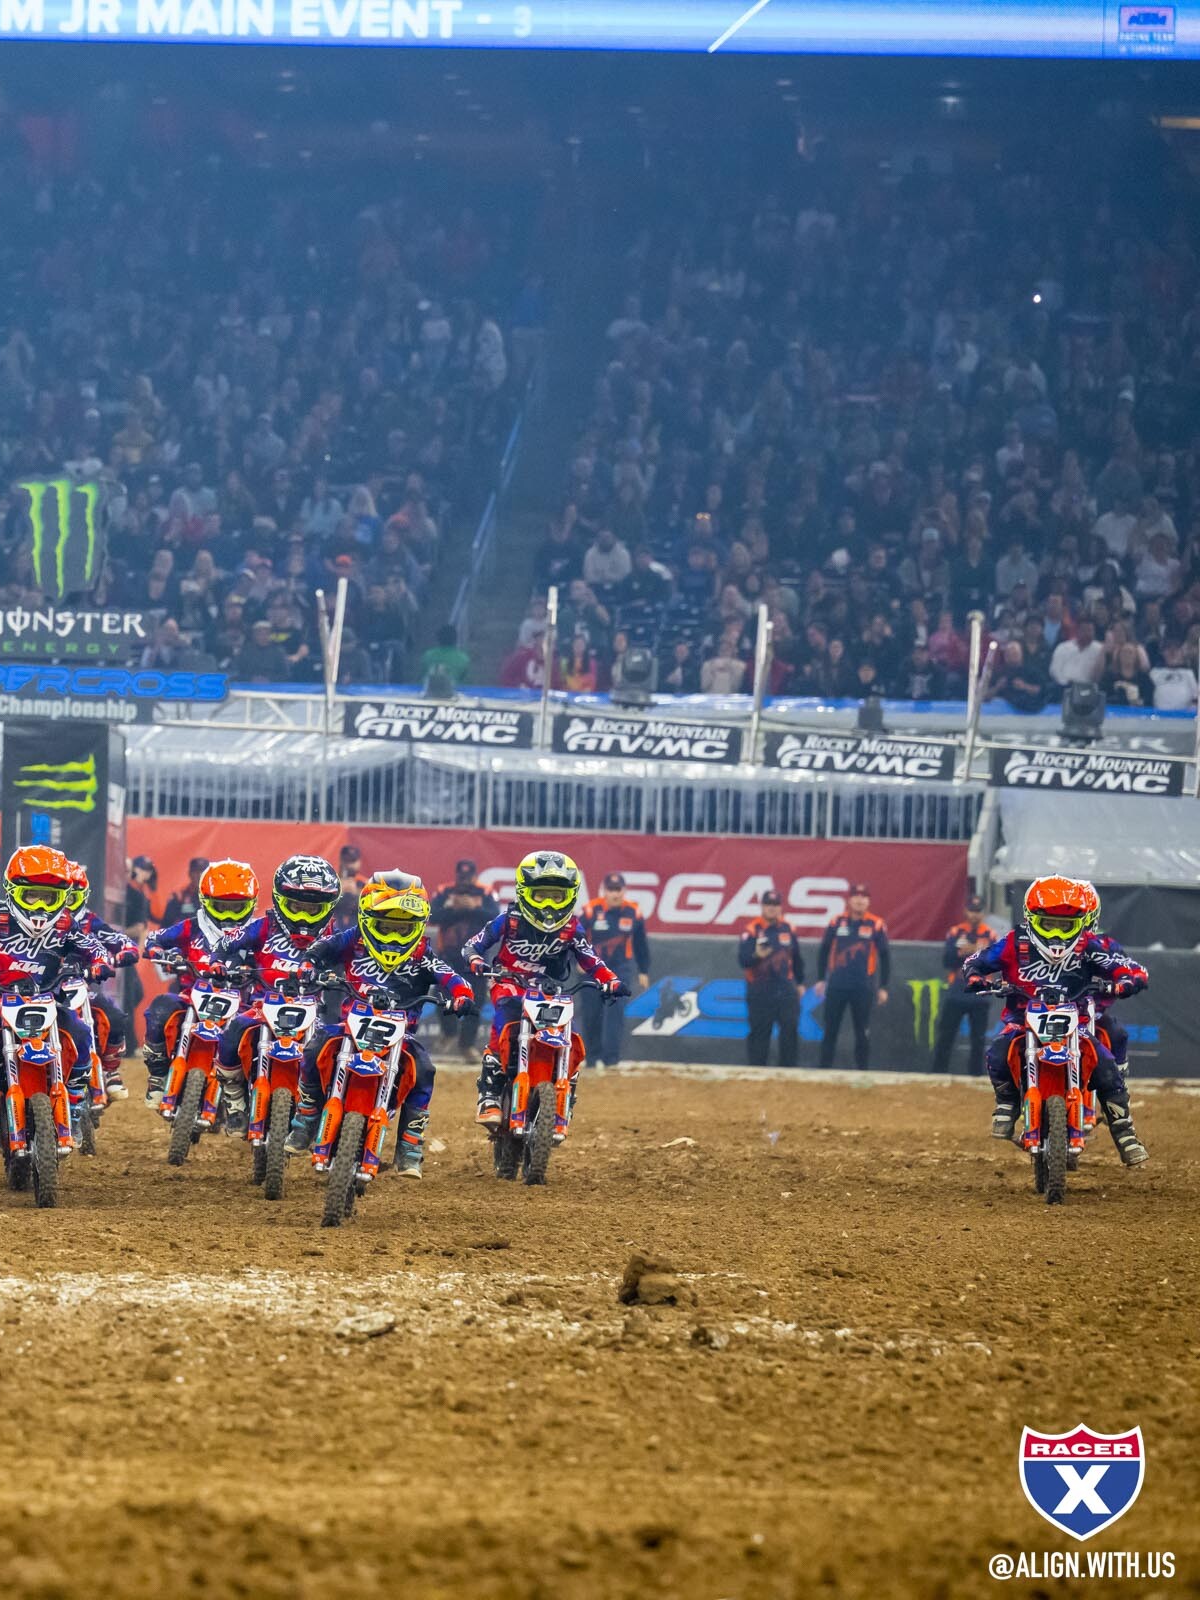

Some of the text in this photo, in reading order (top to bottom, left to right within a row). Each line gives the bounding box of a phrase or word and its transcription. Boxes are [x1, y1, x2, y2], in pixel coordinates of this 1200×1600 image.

[59, 0, 120, 34] JR
[136, 0, 273, 37] MAIN
[290, 0, 461, 39] EVENT
[2, 641, 119, 654] ENERGY
[435, 707, 521, 724] MOUNTAIN
[644, 721, 731, 741] MOUNTAIN
[858, 738, 944, 758] MOUNTAIN
[1085, 756, 1172, 775] MOUNTAIN
[9, 961, 46, 975] KTM
[512, 960, 547, 974] KTM
[16, 1006, 48, 1030] 6
[274, 1006, 307, 1028] 9
[1037, 1014, 1072, 1036] 13
[355, 1017, 397, 1046] 12
